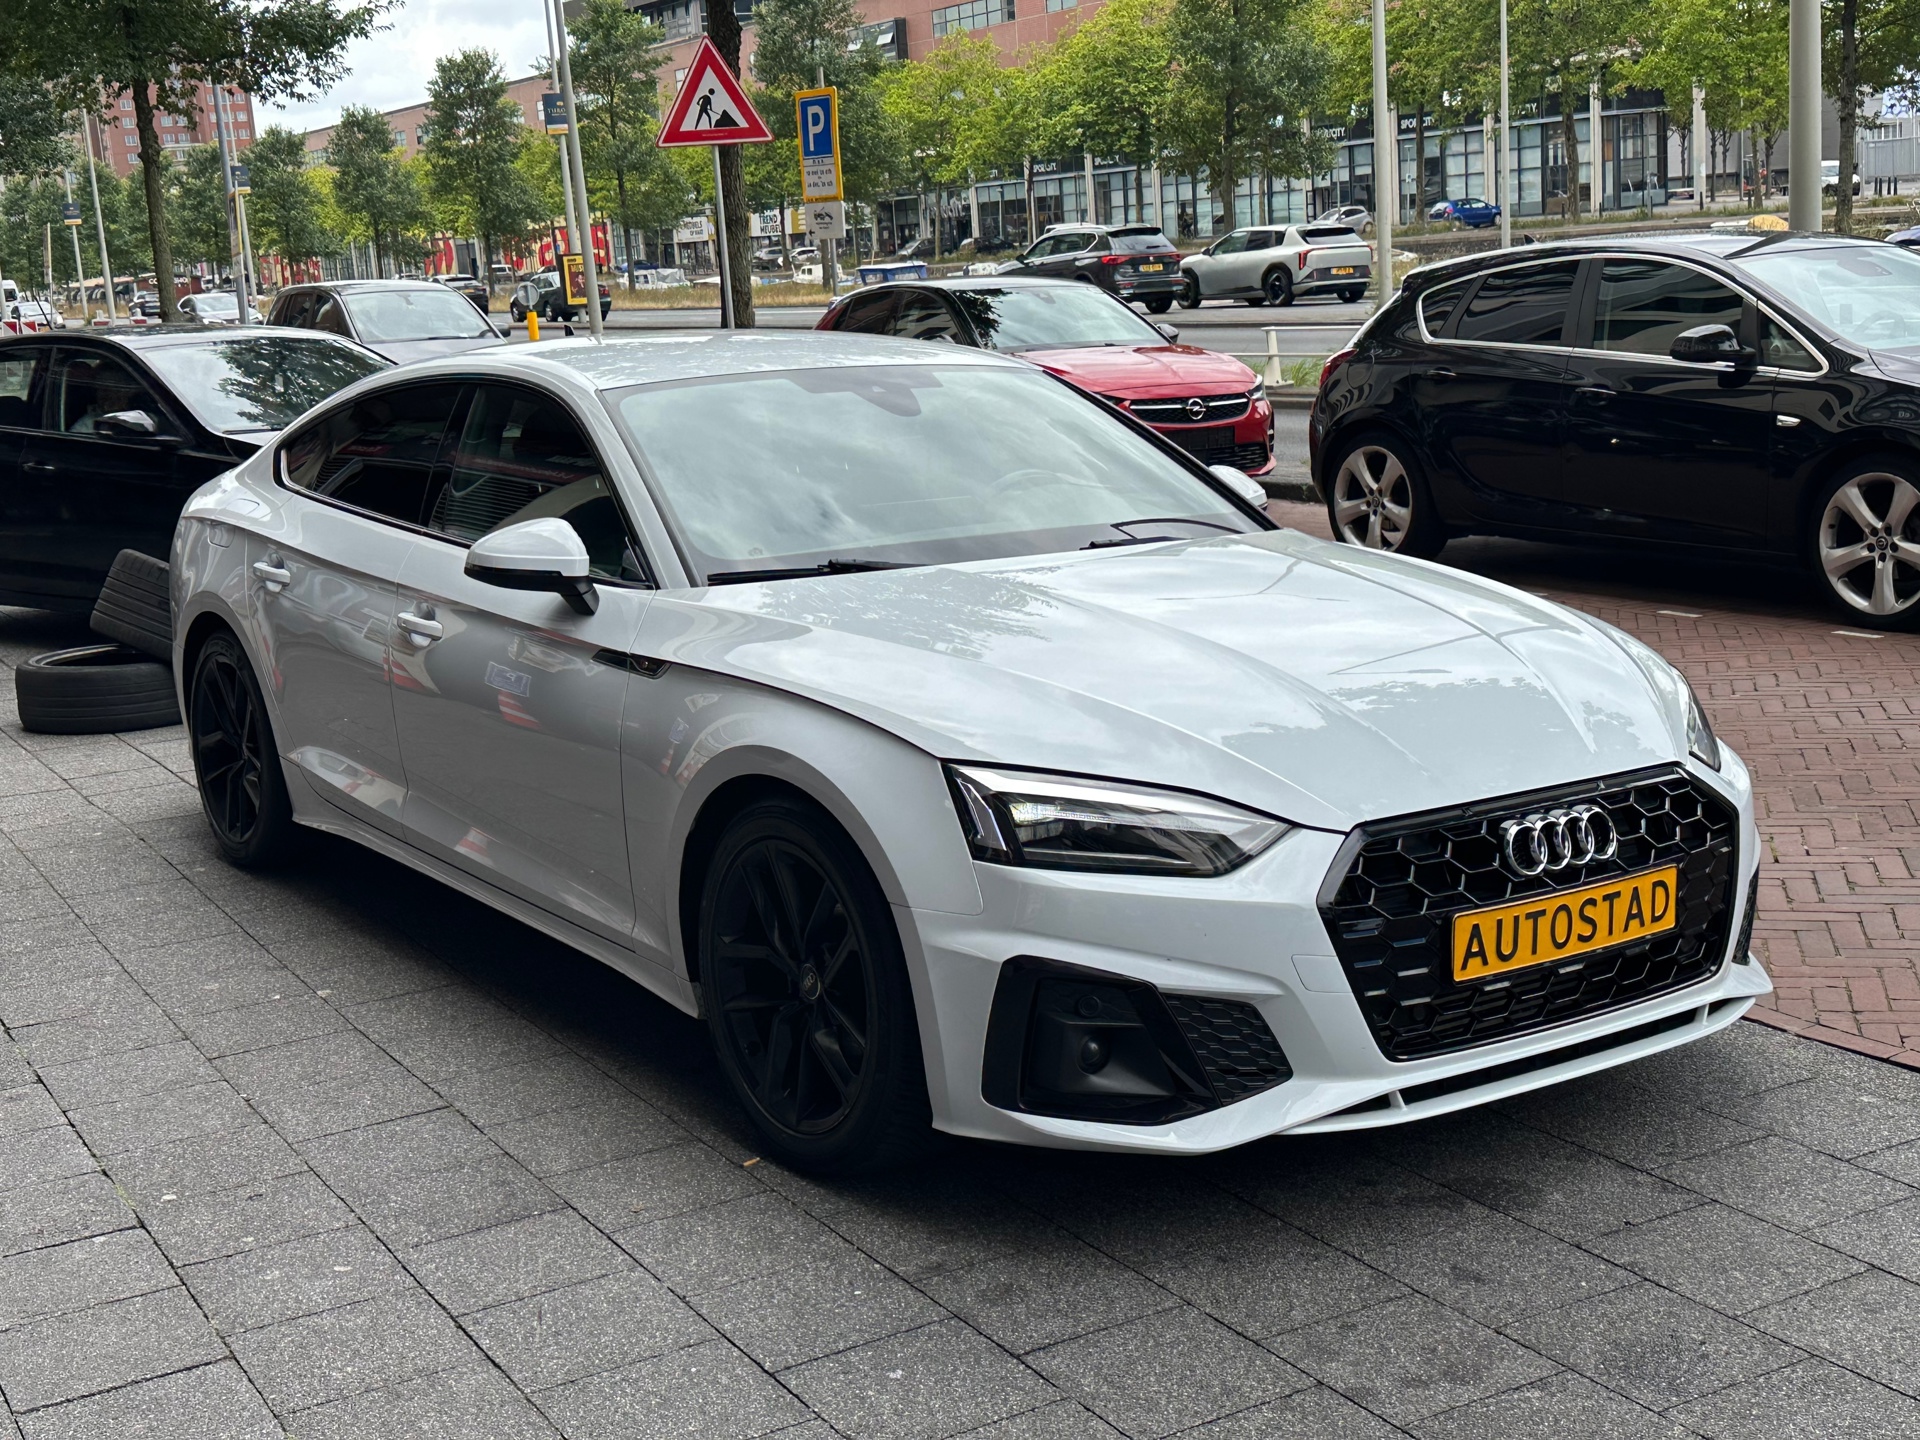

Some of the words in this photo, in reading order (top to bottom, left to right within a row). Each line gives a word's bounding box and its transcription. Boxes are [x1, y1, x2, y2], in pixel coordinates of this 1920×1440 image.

[807, 105, 825, 152] P
[759, 214, 778, 224] TREND
[1460, 879, 1671, 971] AUTOSTAD
